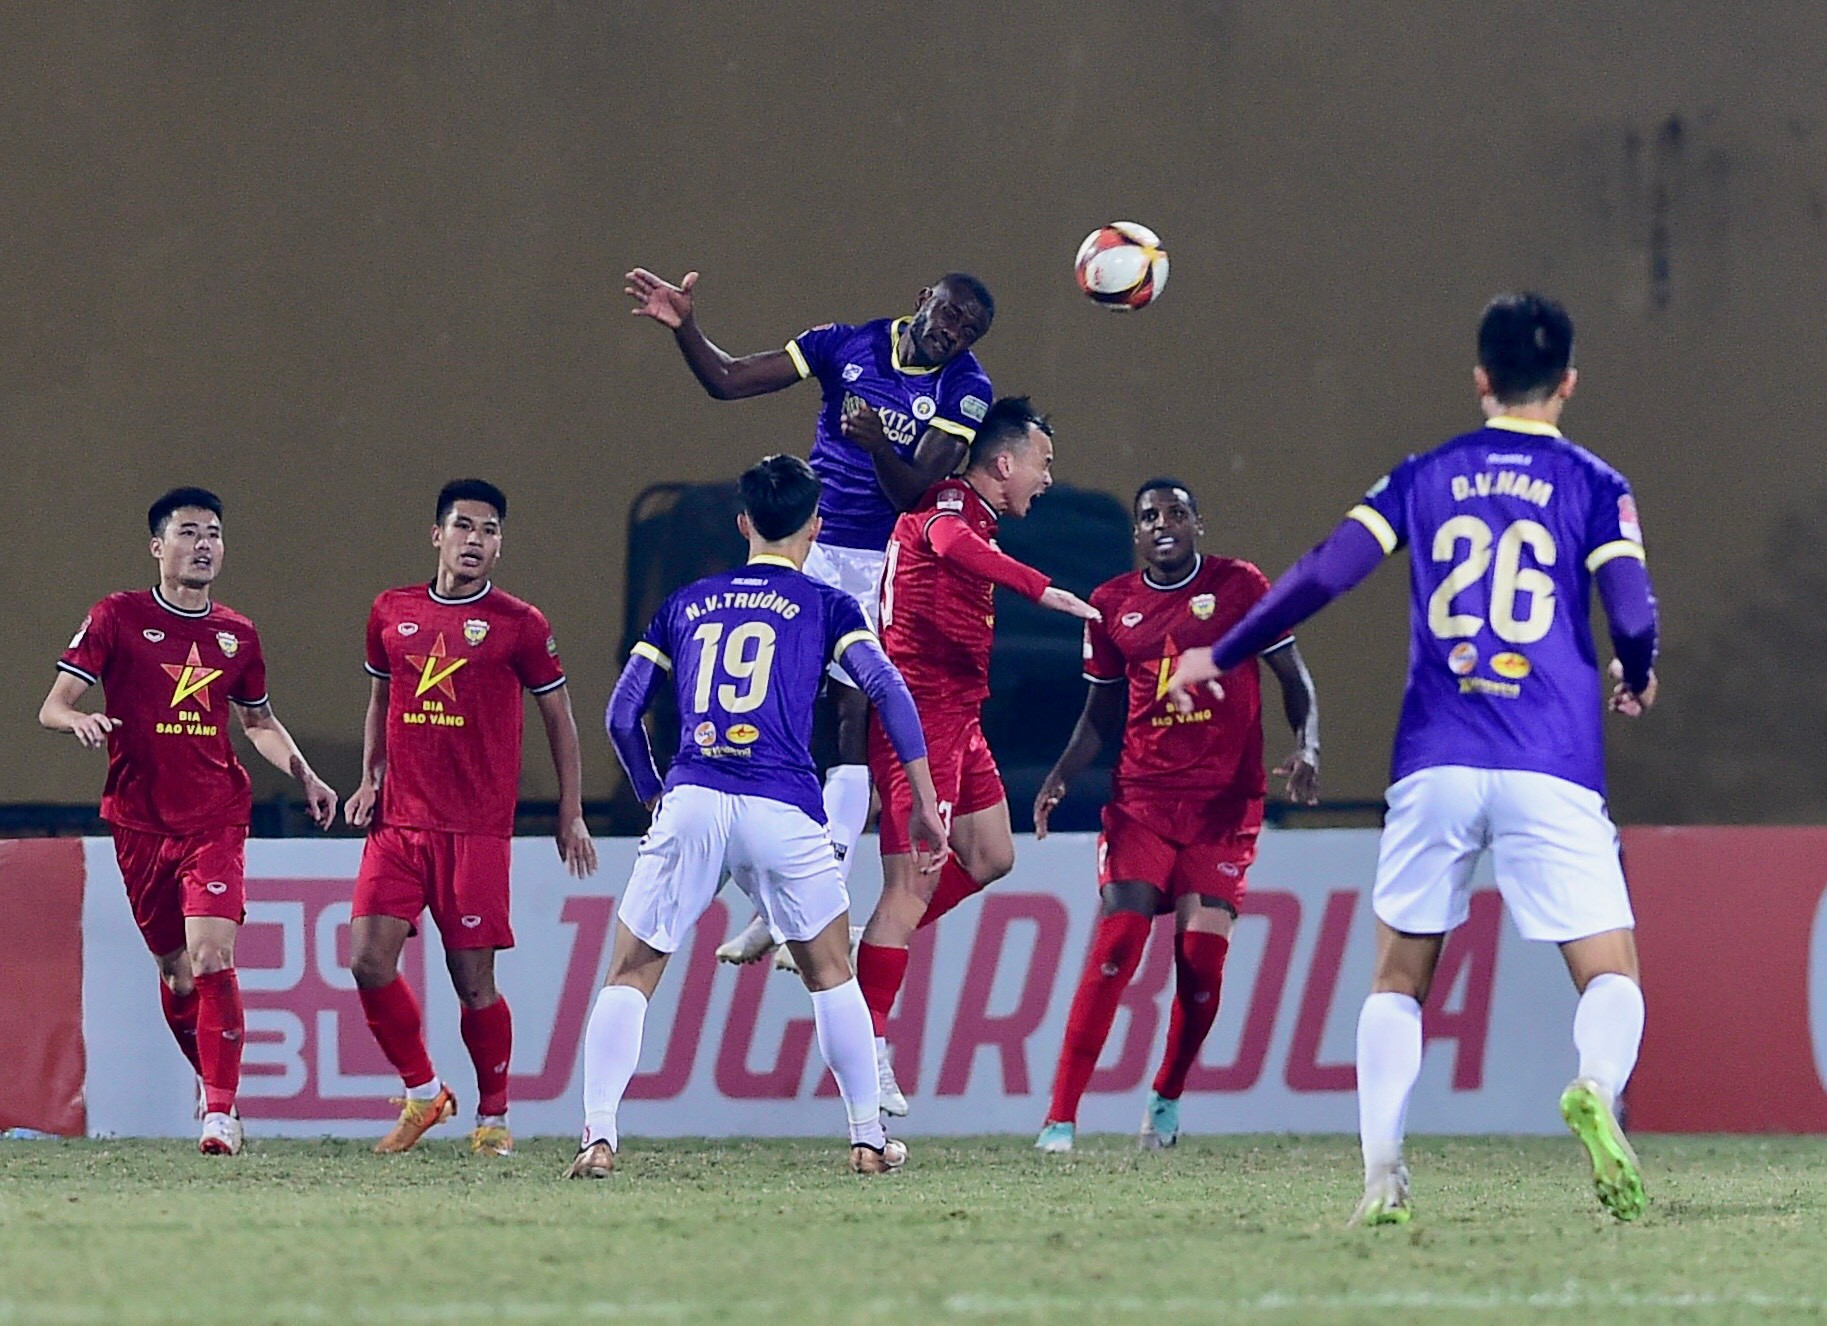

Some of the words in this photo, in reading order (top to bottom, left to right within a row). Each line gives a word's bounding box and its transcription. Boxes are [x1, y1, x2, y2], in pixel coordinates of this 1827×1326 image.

[878, 405, 917, 437] KITA
[1428, 514, 1557, 644] 26
[692, 621, 777, 714] 19
[422, 700, 444, 713] BIA
[178, 710, 201, 722] BIA
[402, 712, 427, 724] SAO
[155, 722, 183, 734] SAO
